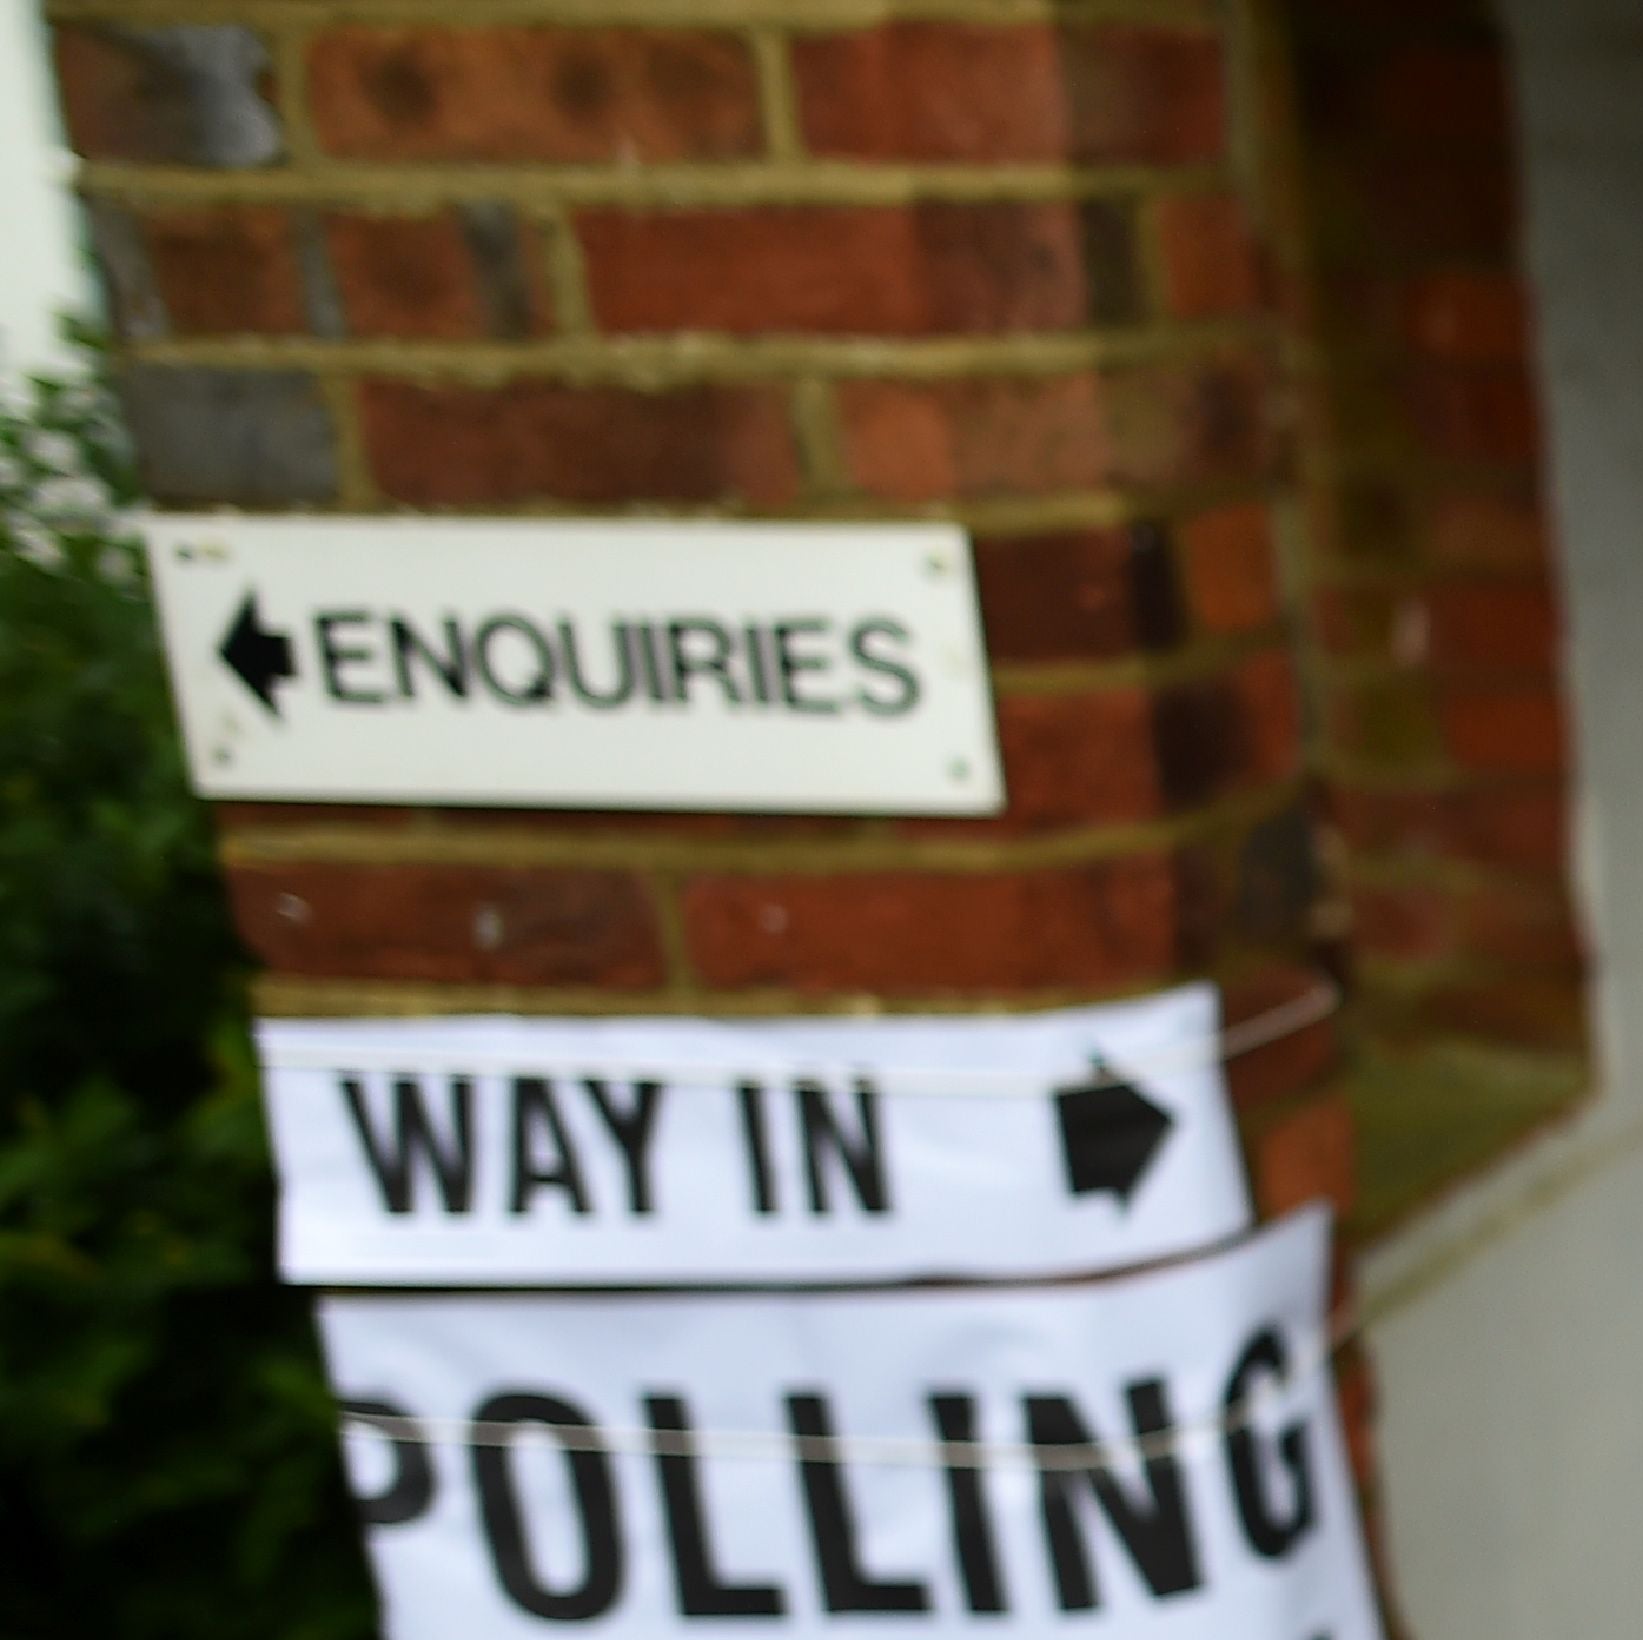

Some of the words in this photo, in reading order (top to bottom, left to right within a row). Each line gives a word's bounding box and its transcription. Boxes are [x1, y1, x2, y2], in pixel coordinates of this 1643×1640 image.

[313, 610, 921, 719] ENQUIRIES
[340, 1073, 664, 1216] WAY
[735, 1073, 891, 1216] IN
